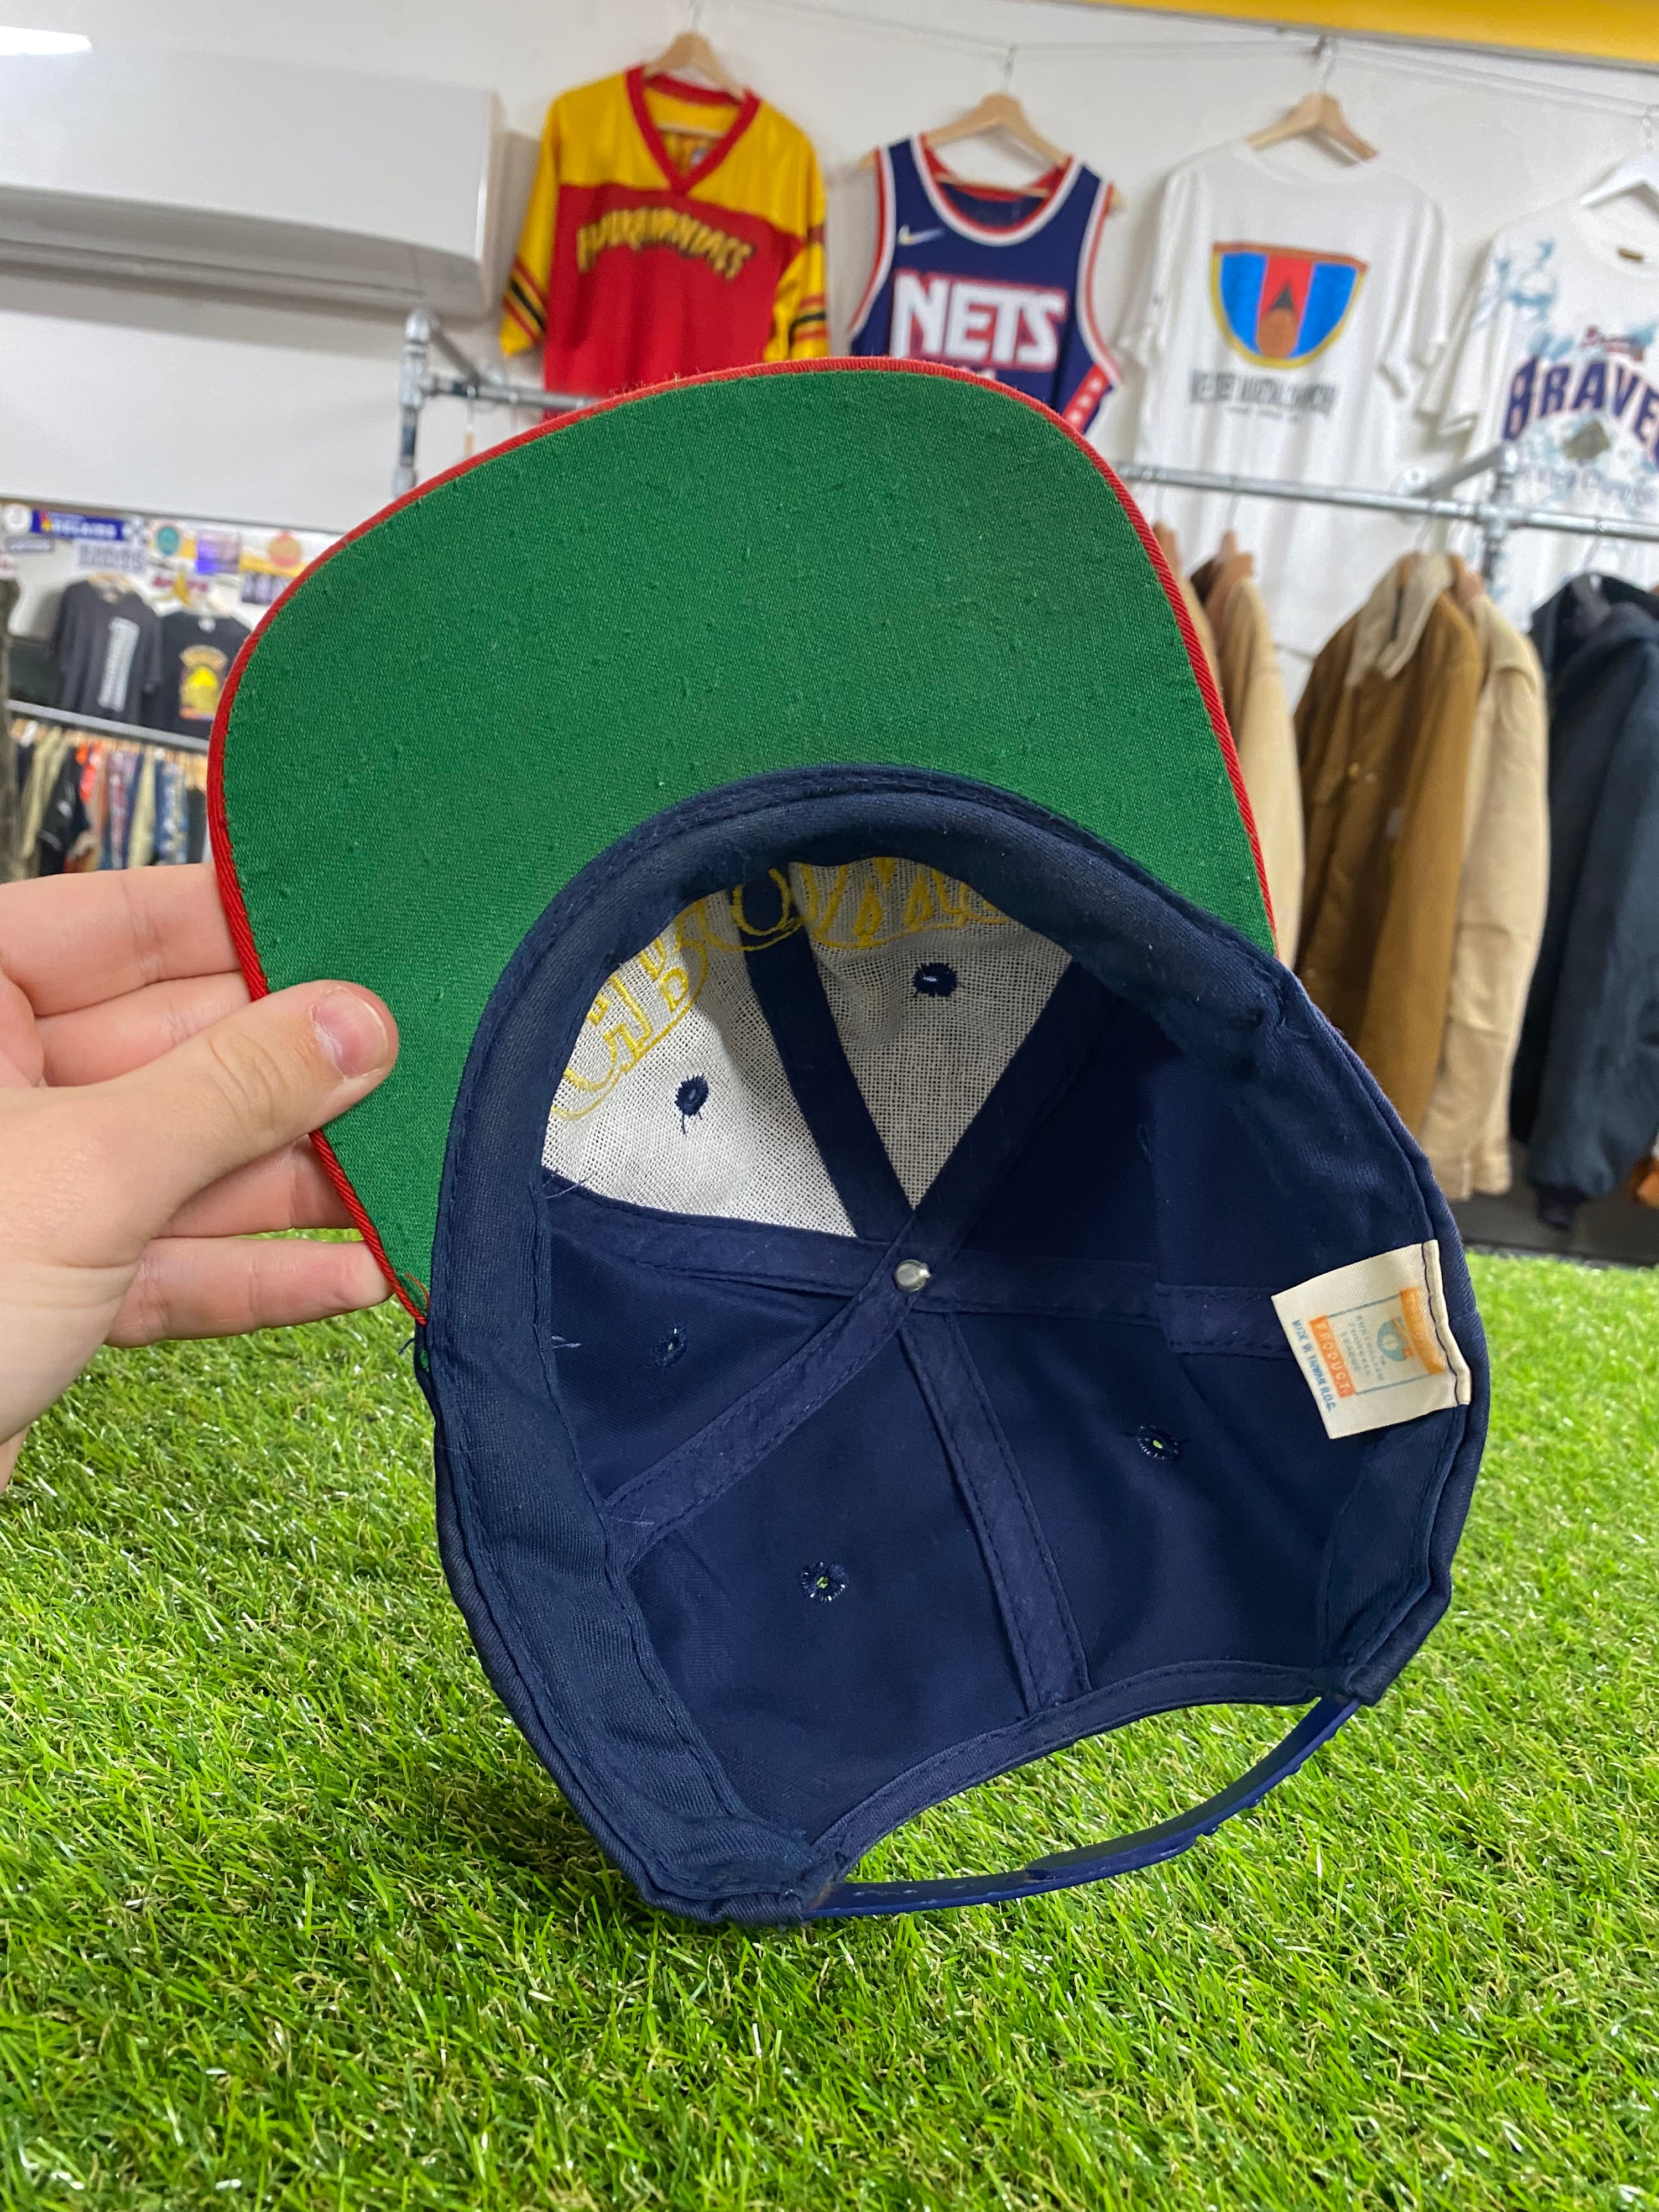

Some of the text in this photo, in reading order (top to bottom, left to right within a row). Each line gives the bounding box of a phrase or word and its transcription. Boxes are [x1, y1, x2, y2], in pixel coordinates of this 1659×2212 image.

[889, 270, 1070, 367] NETS
[1292, 1319, 1308, 1340] MADE
[1301, 1343, 1313, 1353] IN
[1307, 1355, 1326, 1385] TAIWAN
[1316, 1321, 1353, 1393] PRODUCT
